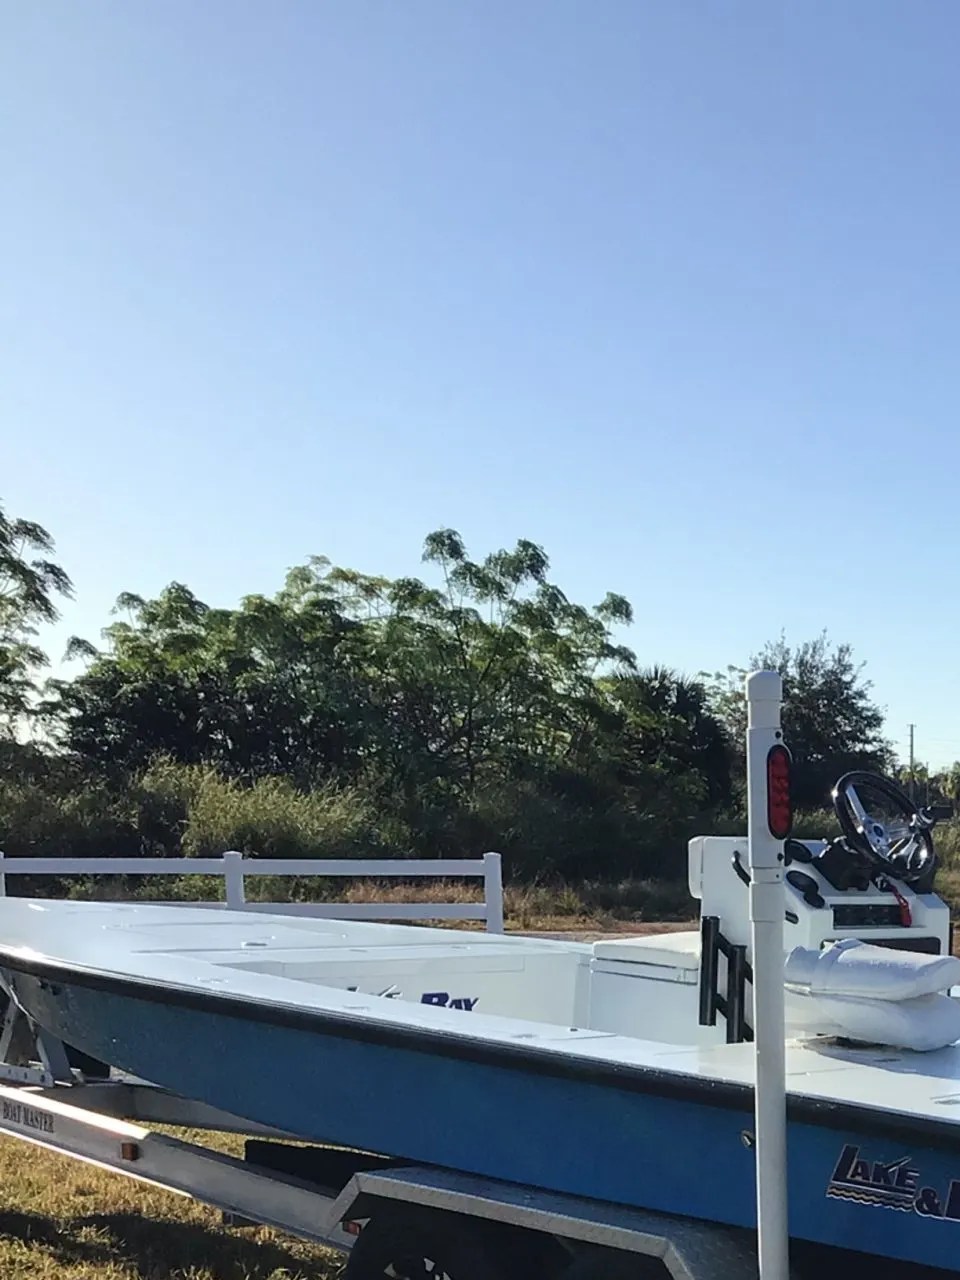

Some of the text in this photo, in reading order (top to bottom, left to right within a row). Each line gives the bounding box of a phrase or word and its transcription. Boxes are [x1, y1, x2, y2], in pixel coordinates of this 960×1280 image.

[3, 1101, 55, 1134] BOAT MASTER
[831, 1144, 920, 1198] LAKE
